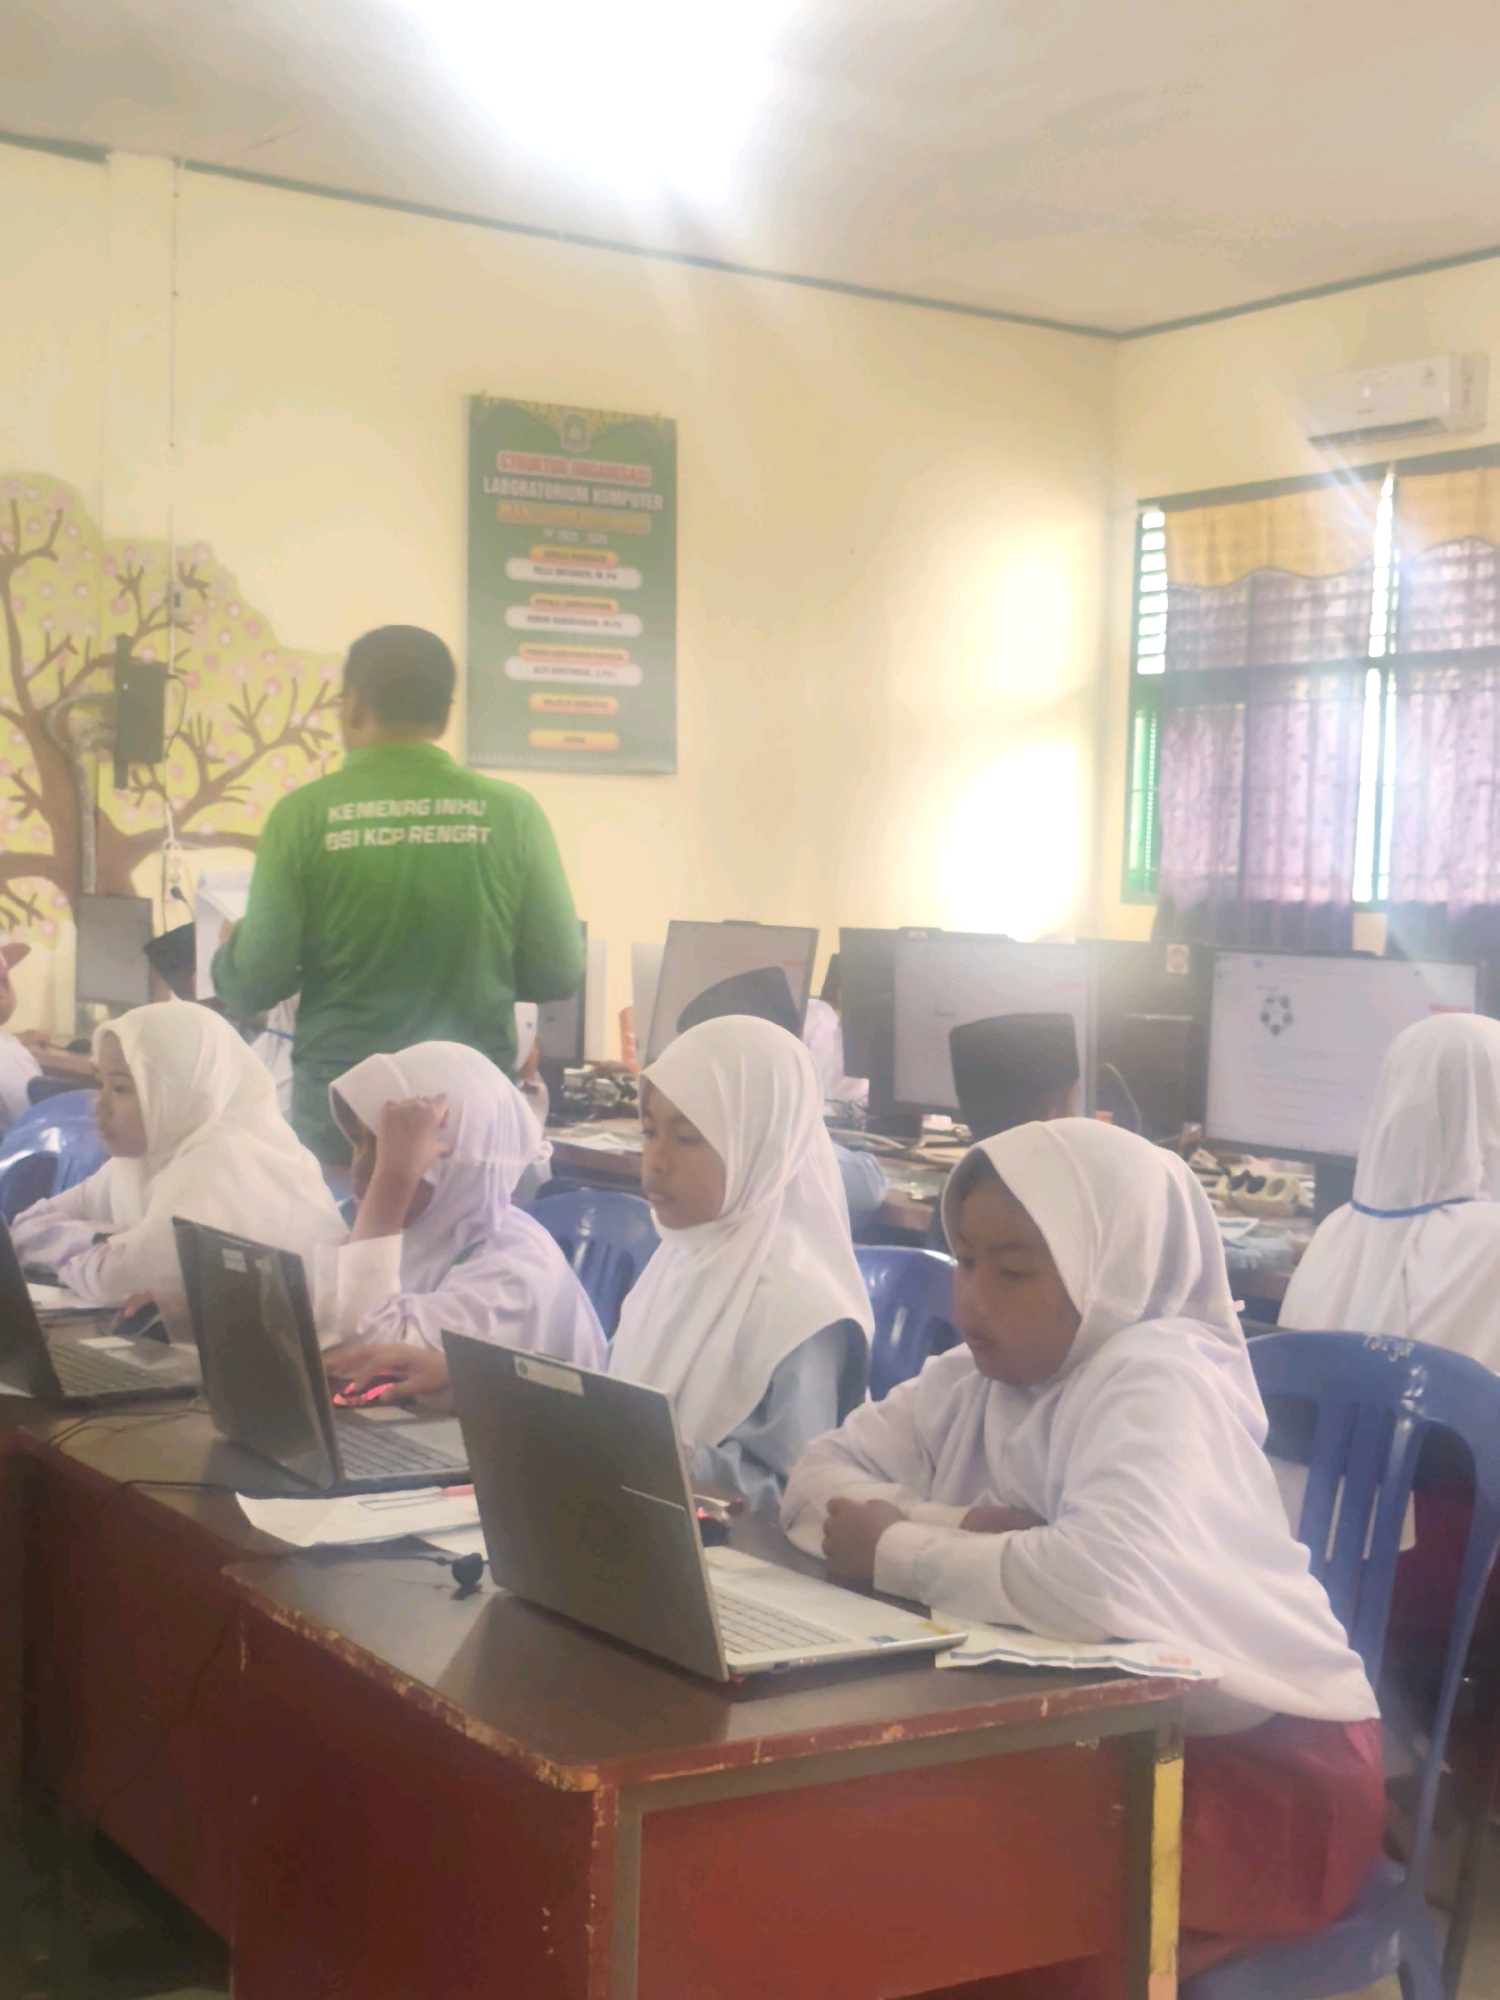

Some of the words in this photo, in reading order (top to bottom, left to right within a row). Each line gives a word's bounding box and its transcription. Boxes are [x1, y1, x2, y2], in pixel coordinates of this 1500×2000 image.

[482, 475, 590, 504] LABORATORIUM
[591, 487, 663, 511] KOMPUTER
[327, 799, 432, 823] KEMENAG
[363, 826, 405, 846] KCP
[408, 824, 491, 845] RENGAT
